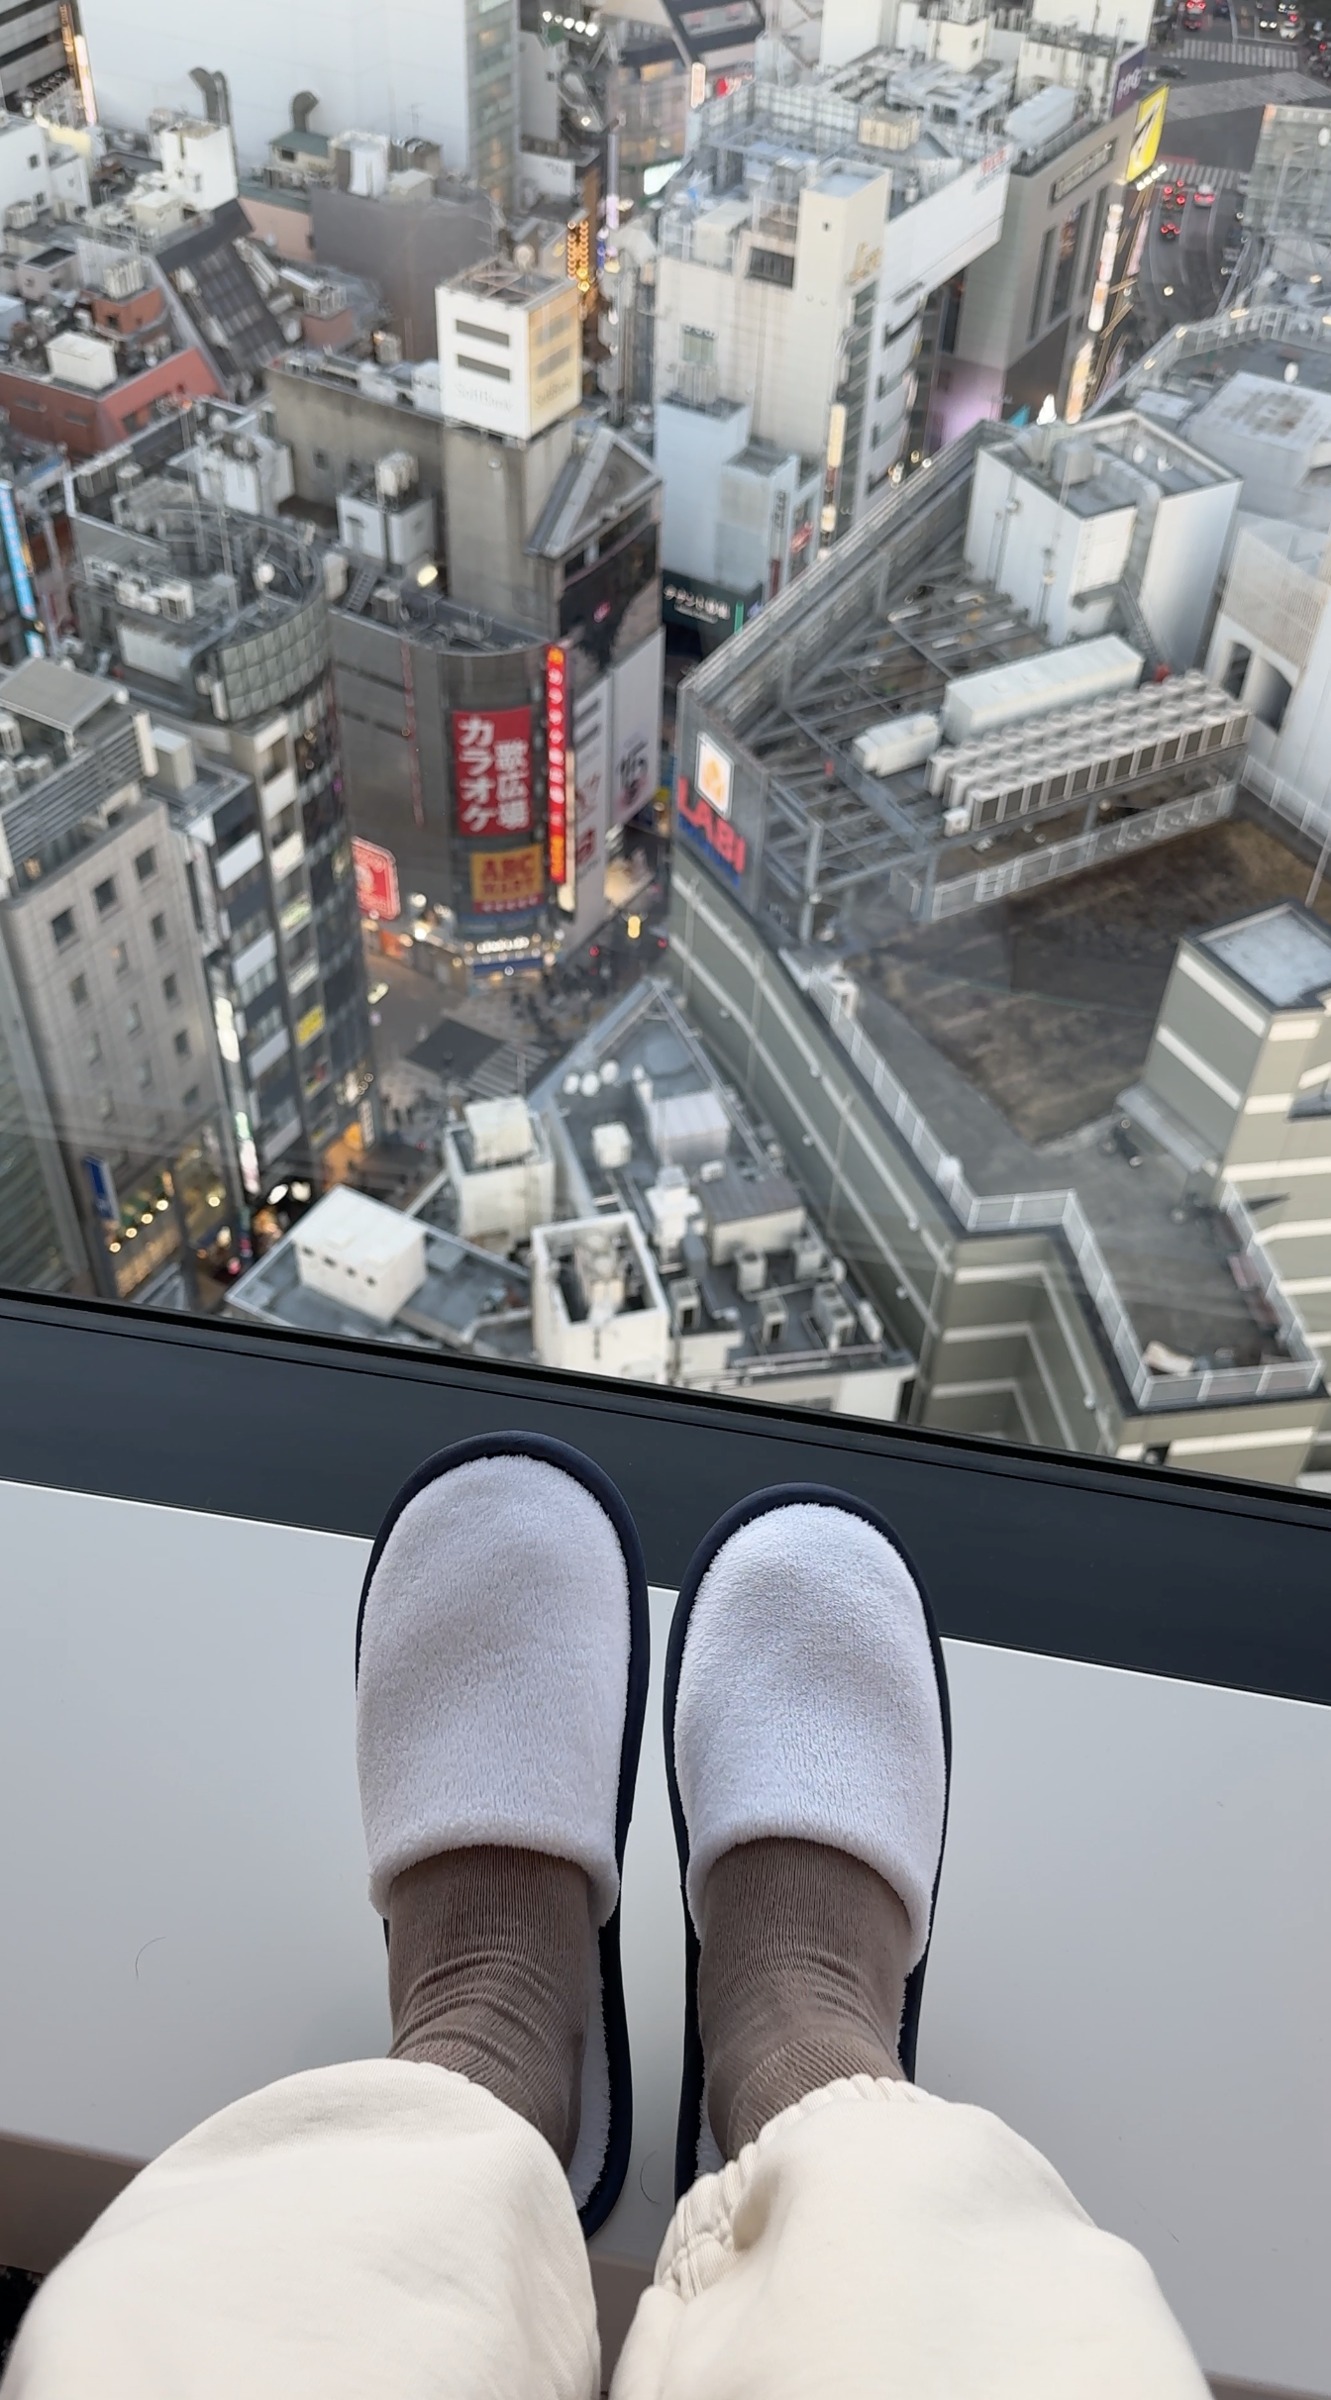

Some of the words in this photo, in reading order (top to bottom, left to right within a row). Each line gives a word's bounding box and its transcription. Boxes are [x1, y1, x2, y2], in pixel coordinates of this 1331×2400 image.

[457, 714, 496, 832] カラオケ
[677, 776, 746, 873] LABI
